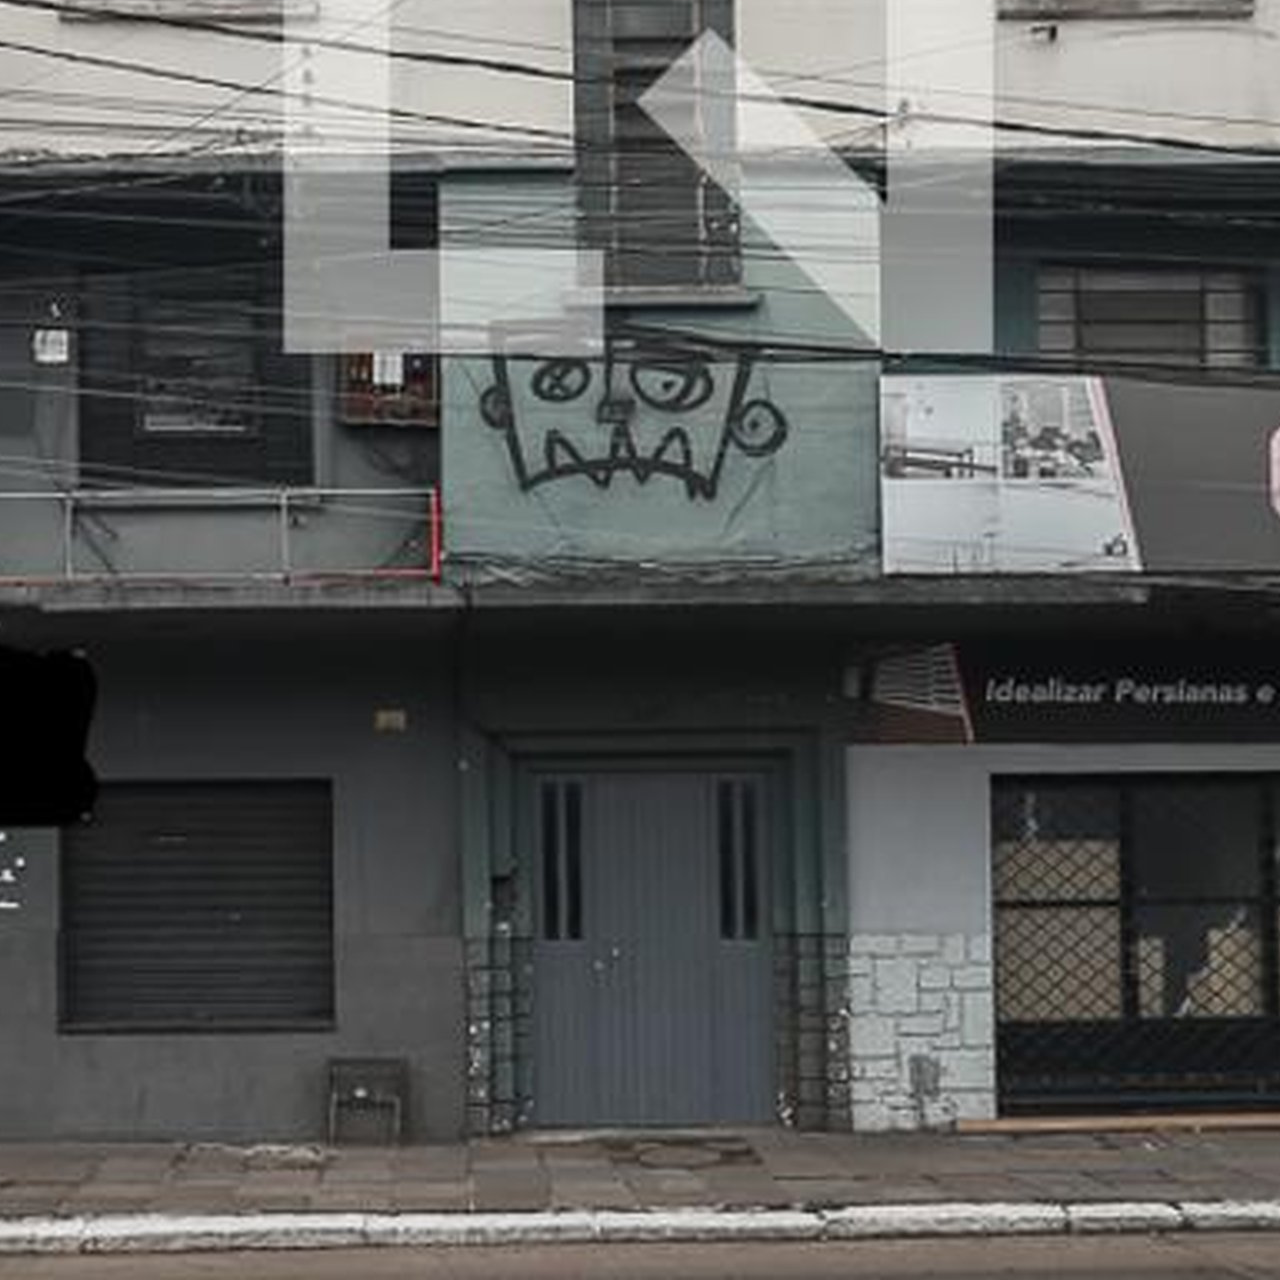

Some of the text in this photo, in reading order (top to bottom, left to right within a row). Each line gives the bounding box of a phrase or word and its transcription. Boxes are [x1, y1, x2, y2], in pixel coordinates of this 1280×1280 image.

[986, 678, 1105, 702] Idealizar
[1115, 679, 1248, 702] Persianas
[1257, 687, 1276, 702] e
